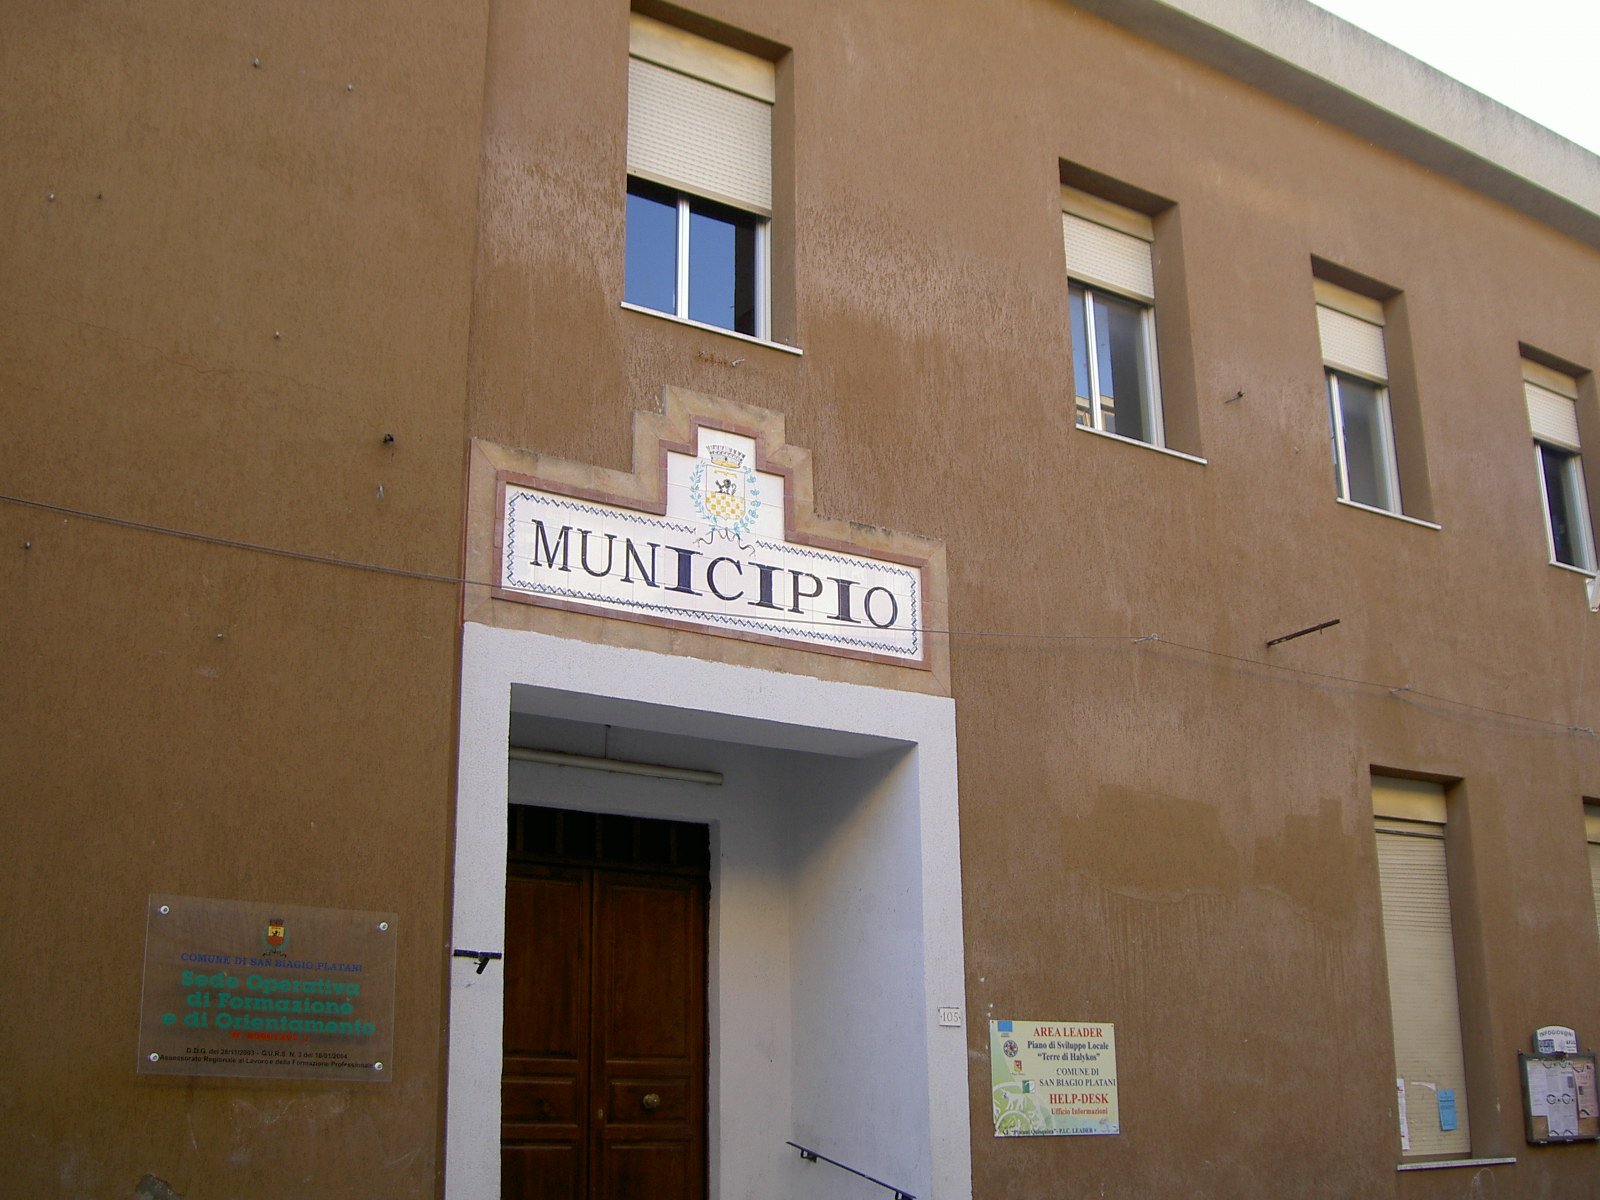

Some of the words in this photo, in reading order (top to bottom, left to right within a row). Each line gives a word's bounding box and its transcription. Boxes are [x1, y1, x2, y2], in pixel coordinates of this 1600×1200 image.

[530, 519, 898, 629] MUNICIPIO
[180, 952, 230, 965] COMUNE
[234, 956, 247, 966] DI
[250, 957, 273, 968] SAN
[275, 958, 313, 970] BIAGIO
[316, 961, 362, 972] PLATANI
[180, 970, 239, 989] Sede
[246, 974, 359, 997] Operativa
[186, 991, 210, 1008] di
[217, 992, 353, 1014] Formazione
[942, 1011, 959, 1022] 105
[161, 1011, 176, 1025] e
[183, 1011, 208, 1028] di
[215, 1013, 376, 1036] Orientamento
[1033, 1027, 1061, 1037] AREA
[1063, 1027, 1103, 1038] LEADER
[1027, 1041, 1048, 1050] Piano
[1048, 1040, 1056, 1049] di
[1056, 1041, 1087, 1052] Sviluppo
[1088, 1042, 1109, 1050] Locale
[160, 1054, 201, 1062] Assessorato
[203, 1056, 236, 1064] Regionale
[292, 1059, 329, 1067] Formazione
[1062, 1053, 1069, 1061] di
[1056, 1067, 1090, 1076] COMUNE
[1091, 1068, 1099, 1076] DI
[1039, 1079, 1055, 1087] SAN
[1056, 1079, 1084, 1087] BIAGIO
[1085, 1079, 1116, 1087] PLATANI
[1049, 1093, 1109, 1105] HELP-DESK
[1051, 1107, 1070, 1115] Ufficio
[1071, 1107, 1108, 1115] Informazioni
